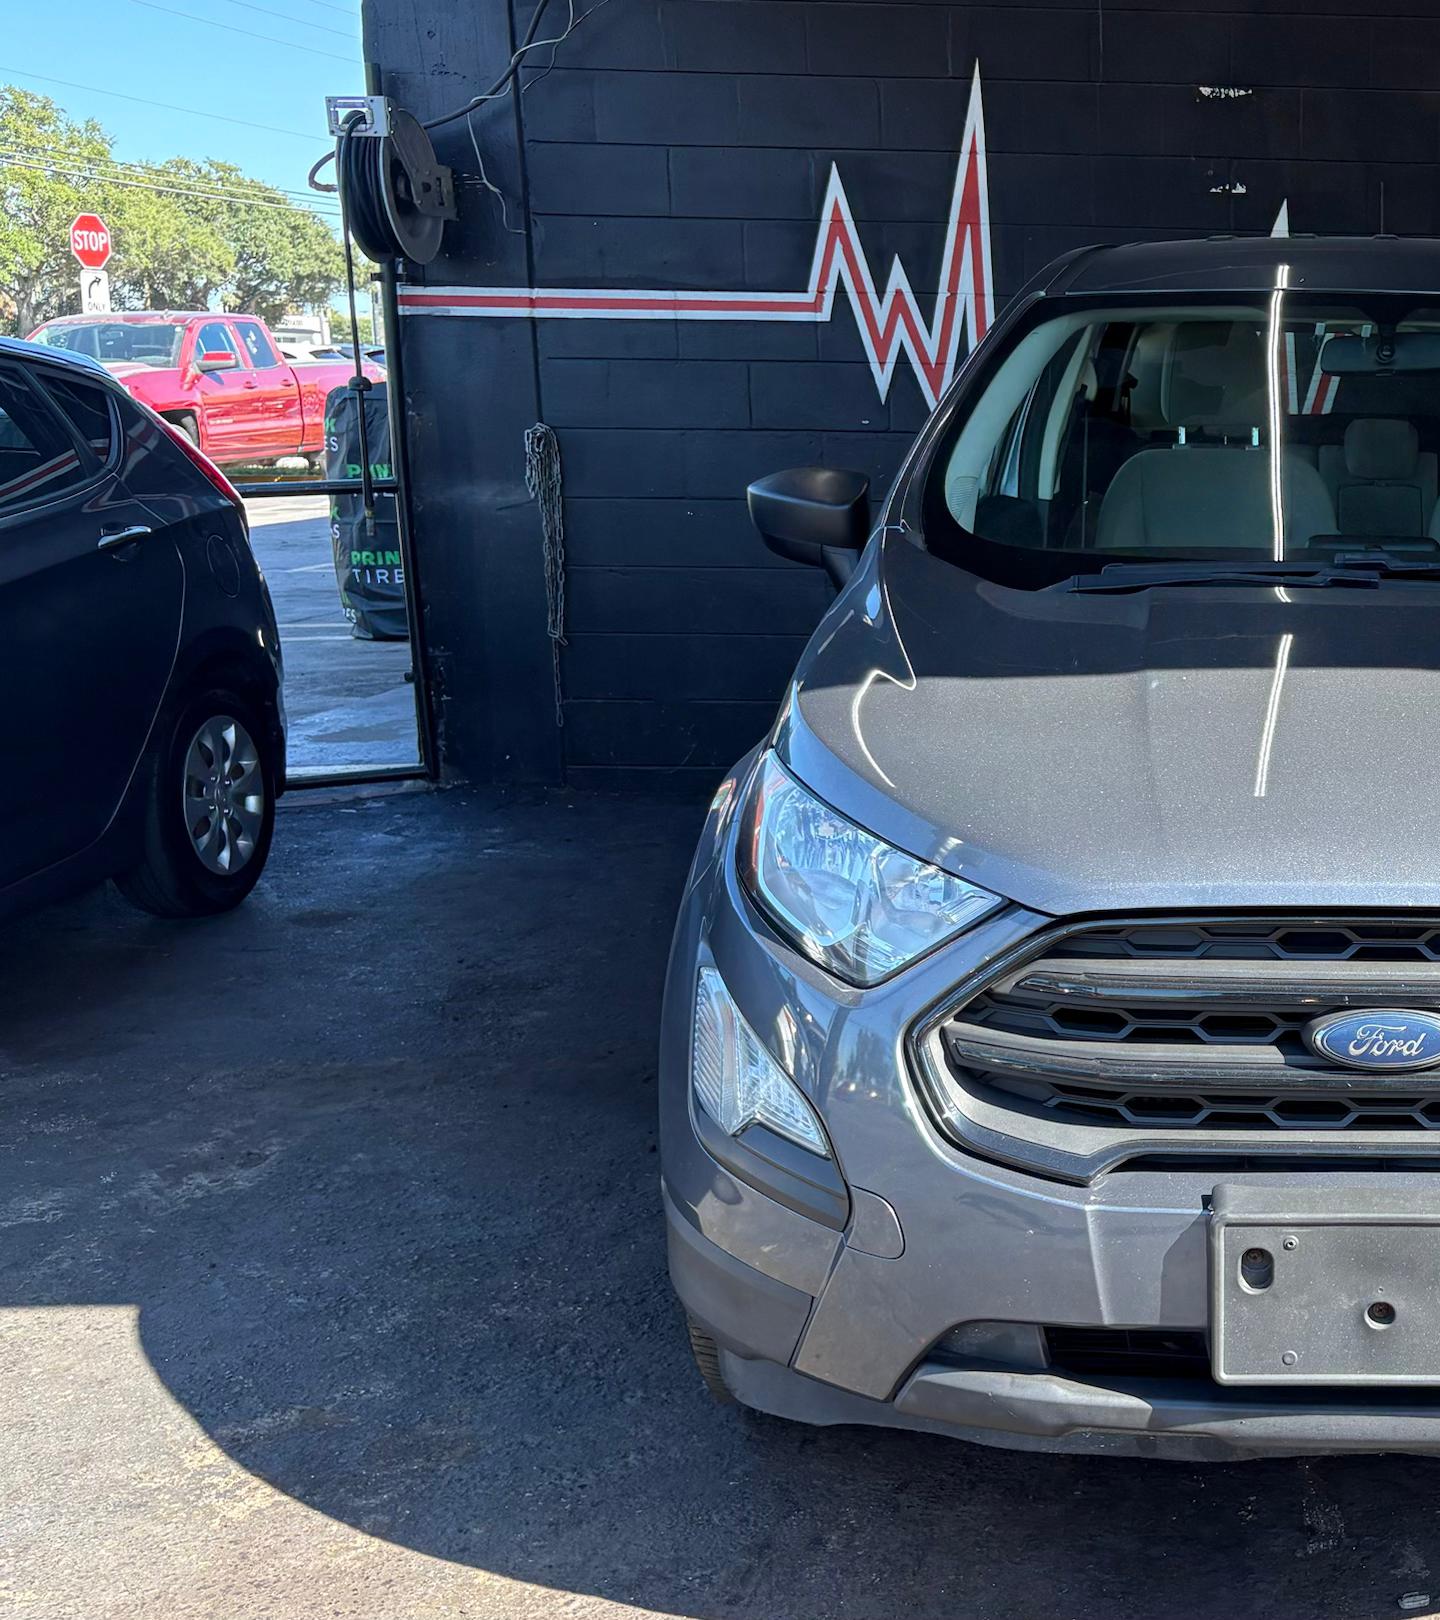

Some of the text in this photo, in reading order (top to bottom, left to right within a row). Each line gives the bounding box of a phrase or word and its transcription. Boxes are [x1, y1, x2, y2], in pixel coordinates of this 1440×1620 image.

[74, 230, 107, 252] STOP
[87, 302, 106, 312] ONLY
[351, 551, 400, 565] PRIN
[352, 569, 404, 584] TIRE
[1349, 1024, 1426, 1057] Ford
